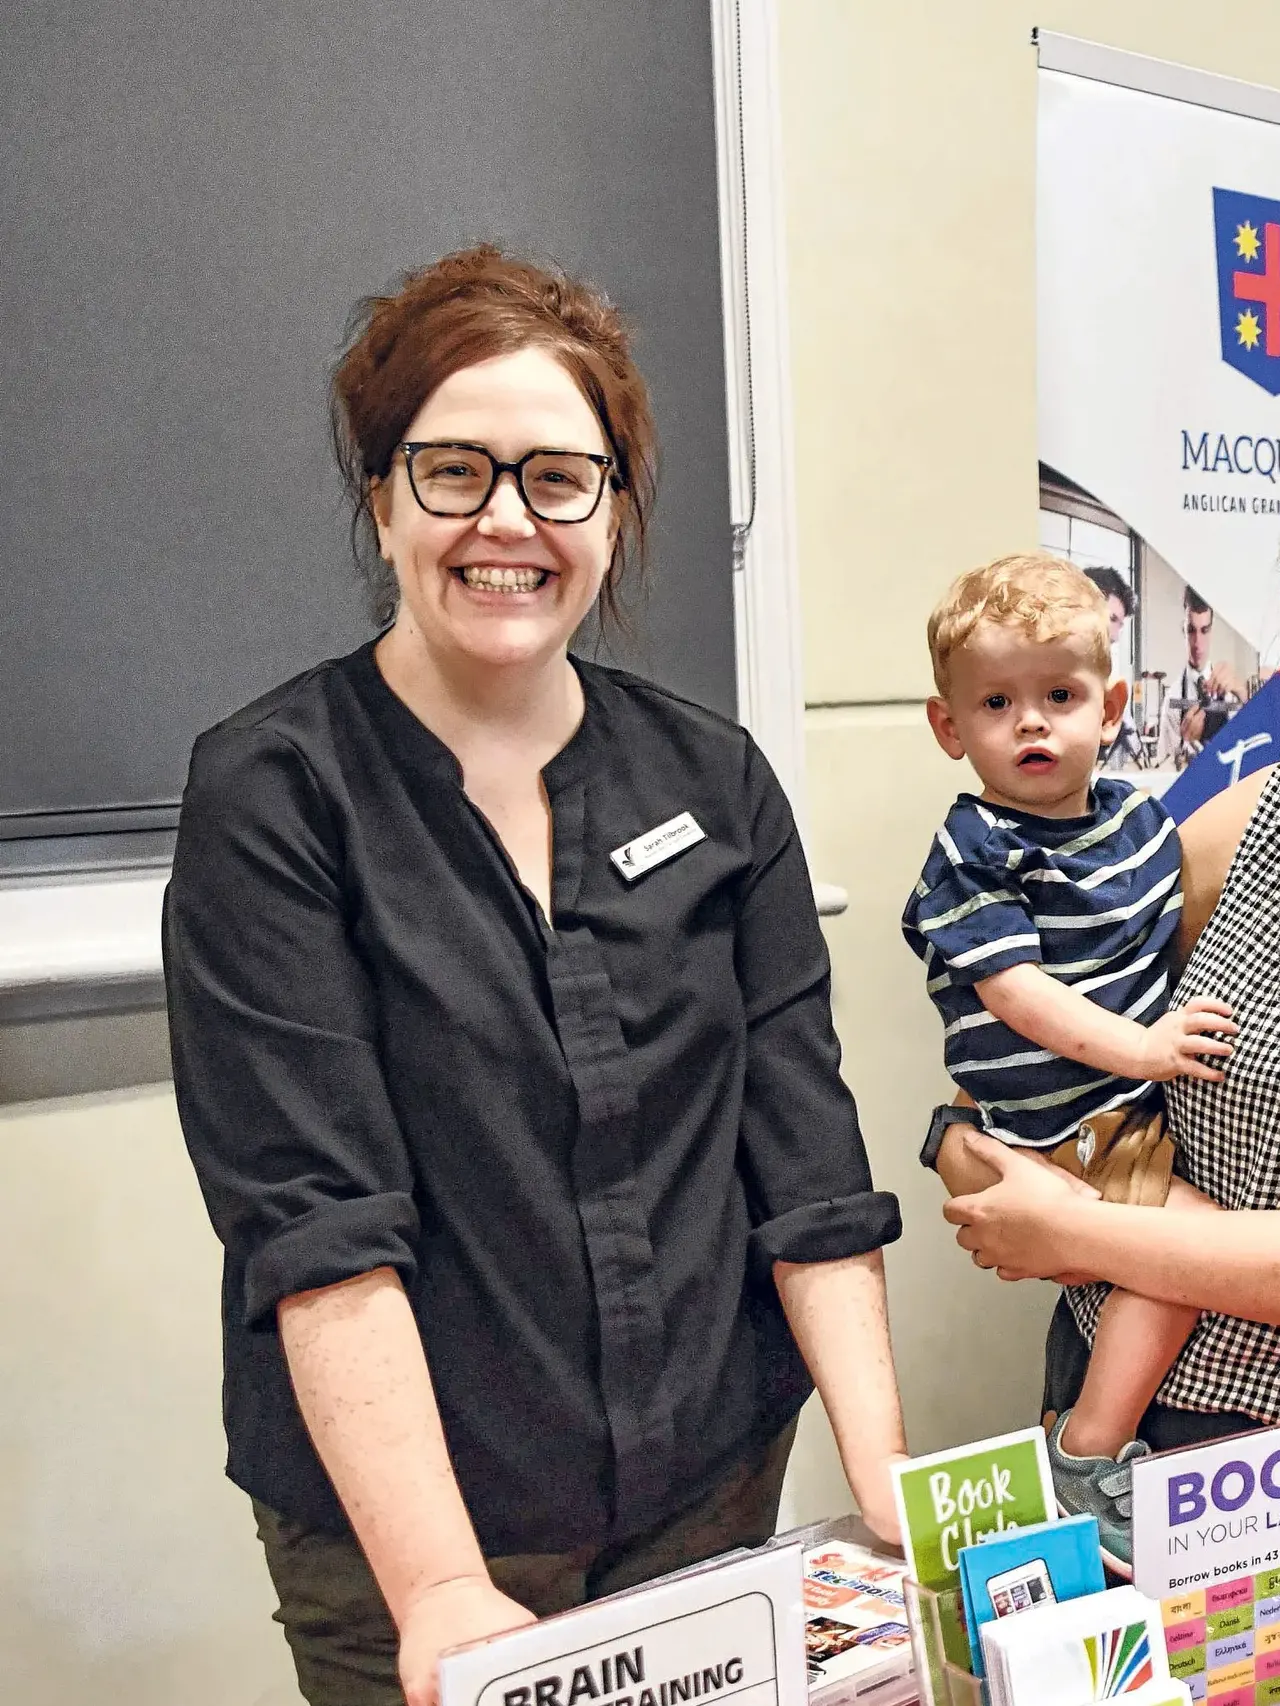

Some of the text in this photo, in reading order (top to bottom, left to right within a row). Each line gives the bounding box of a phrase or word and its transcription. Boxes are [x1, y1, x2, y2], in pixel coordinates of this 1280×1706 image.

[1184, 494, 1246, 513] ANGLICAN
[643, 838, 663, 852] Sarah
[929, 1463, 1016, 1524] Book
[941, 1510, 1019, 1572] Clb
[1168, 1536, 1189, 1555] IN
[1197, 1515, 1259, 1549] YOUR
[1169, 1568, 1210, 1590] Borrow
[1214, 1559, 1248, 1578] books
[1251, 1555, 1262, 1568] in
[1265, 1549, 1279, 1563] 43
[600, 1657, 744, 1706] AINING
[1169, 1657, 1195, 1671] Deutsch
